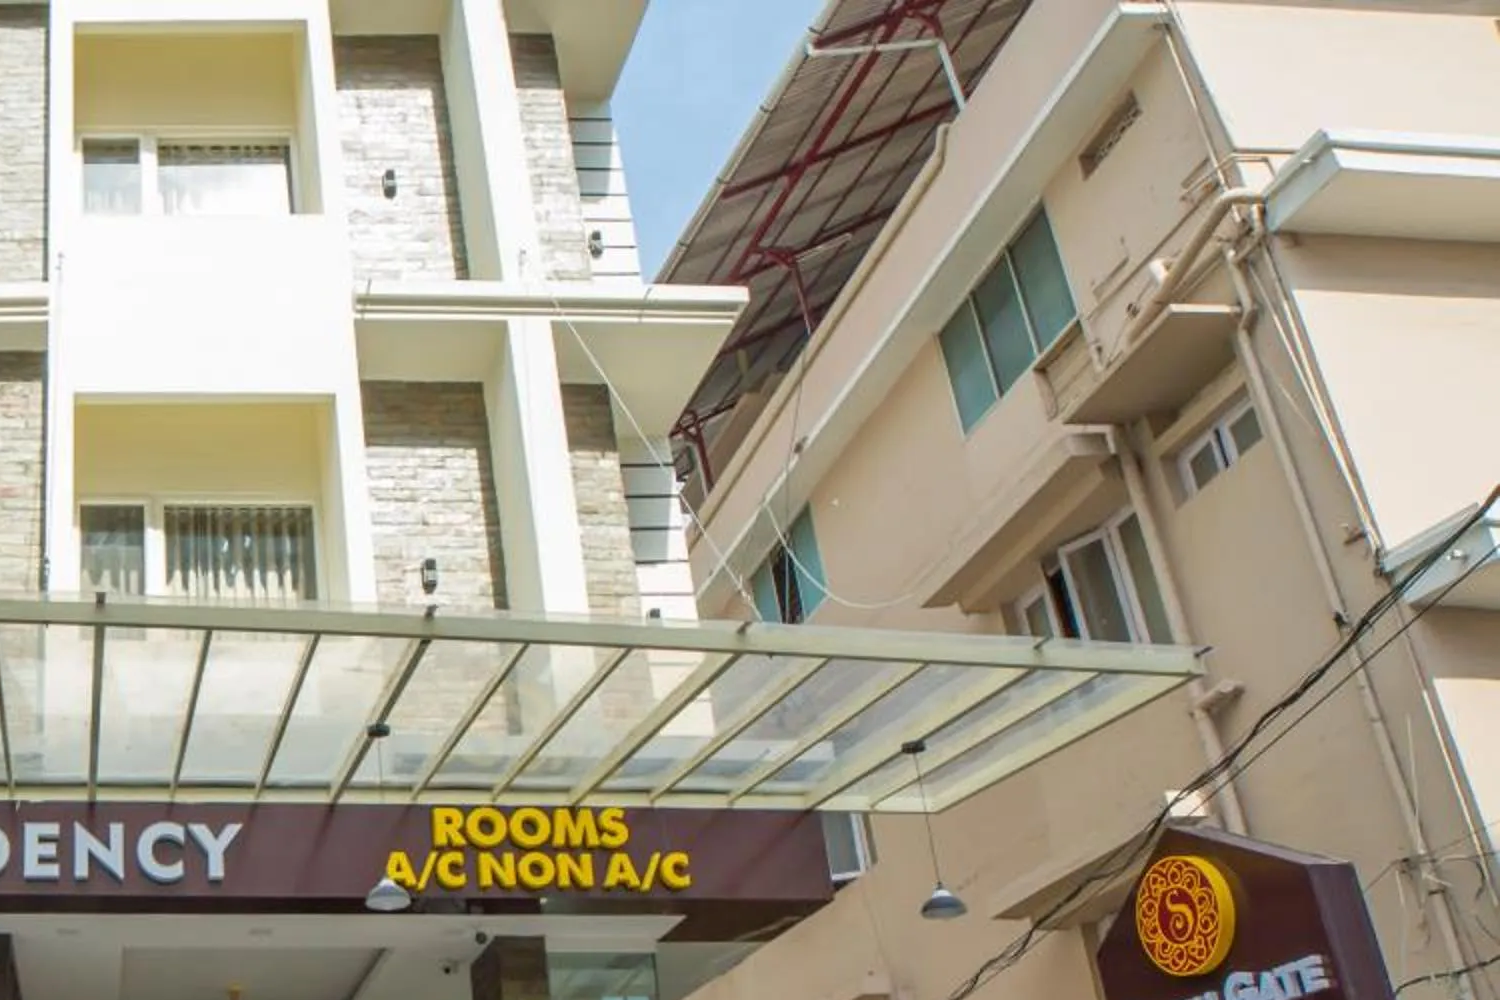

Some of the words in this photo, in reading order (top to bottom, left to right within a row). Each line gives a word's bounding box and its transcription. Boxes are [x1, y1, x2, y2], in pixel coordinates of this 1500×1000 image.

[431, 806, 629, 850] ROOMS
[386, 851, 468, 891] A/C
[478, 852, 594, 890] NON
[603, 851, 691, 892] A/C
